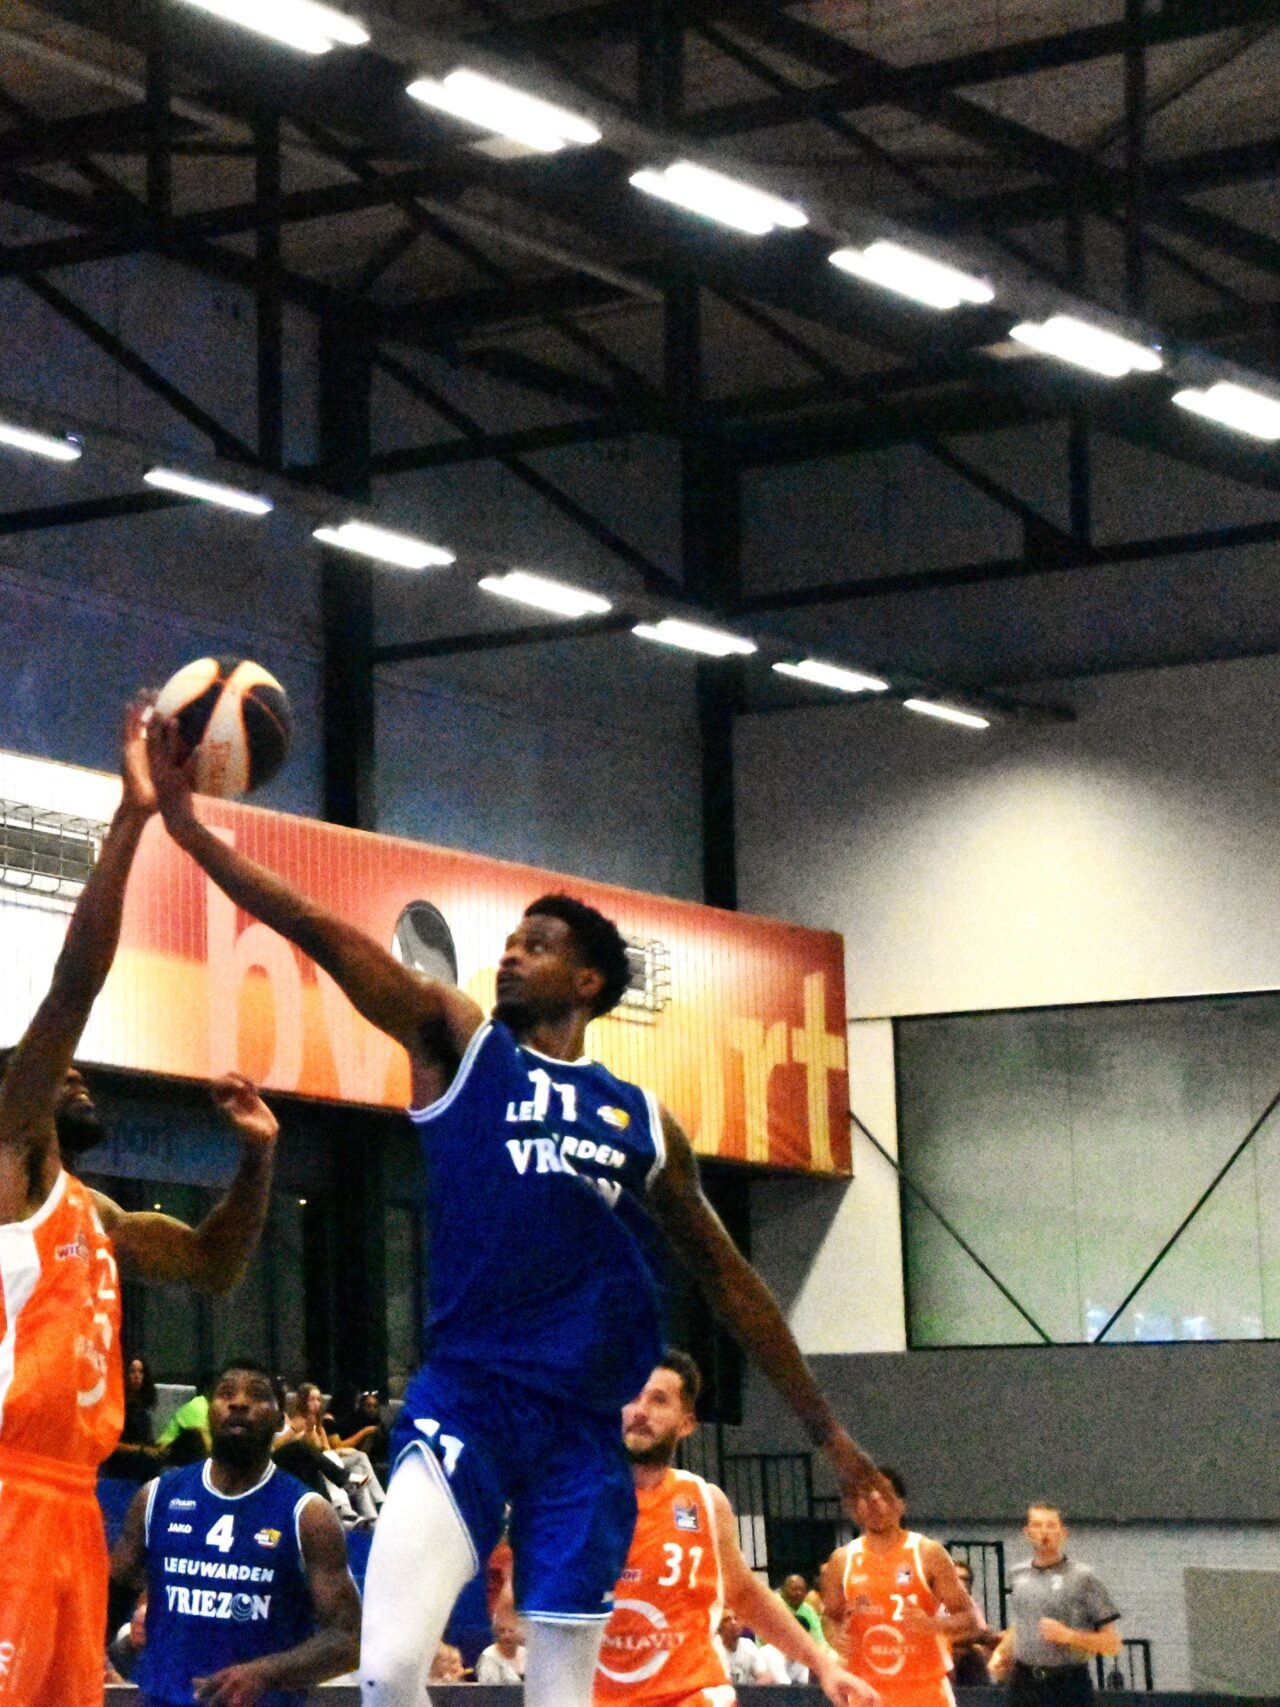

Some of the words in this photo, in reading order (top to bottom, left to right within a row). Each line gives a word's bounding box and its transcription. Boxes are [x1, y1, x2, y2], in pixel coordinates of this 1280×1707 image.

[528, 1068, 577, 1121] 11
[167, 1522, 193, 1534] JAKO
[206, 1514, 234, 1553] 4
[164, 1557, 274, 1583] LEEUWARDEN
[658, 1543, 703, 1588] 31
[165, 1585, 271, 1620] VRIEZON
